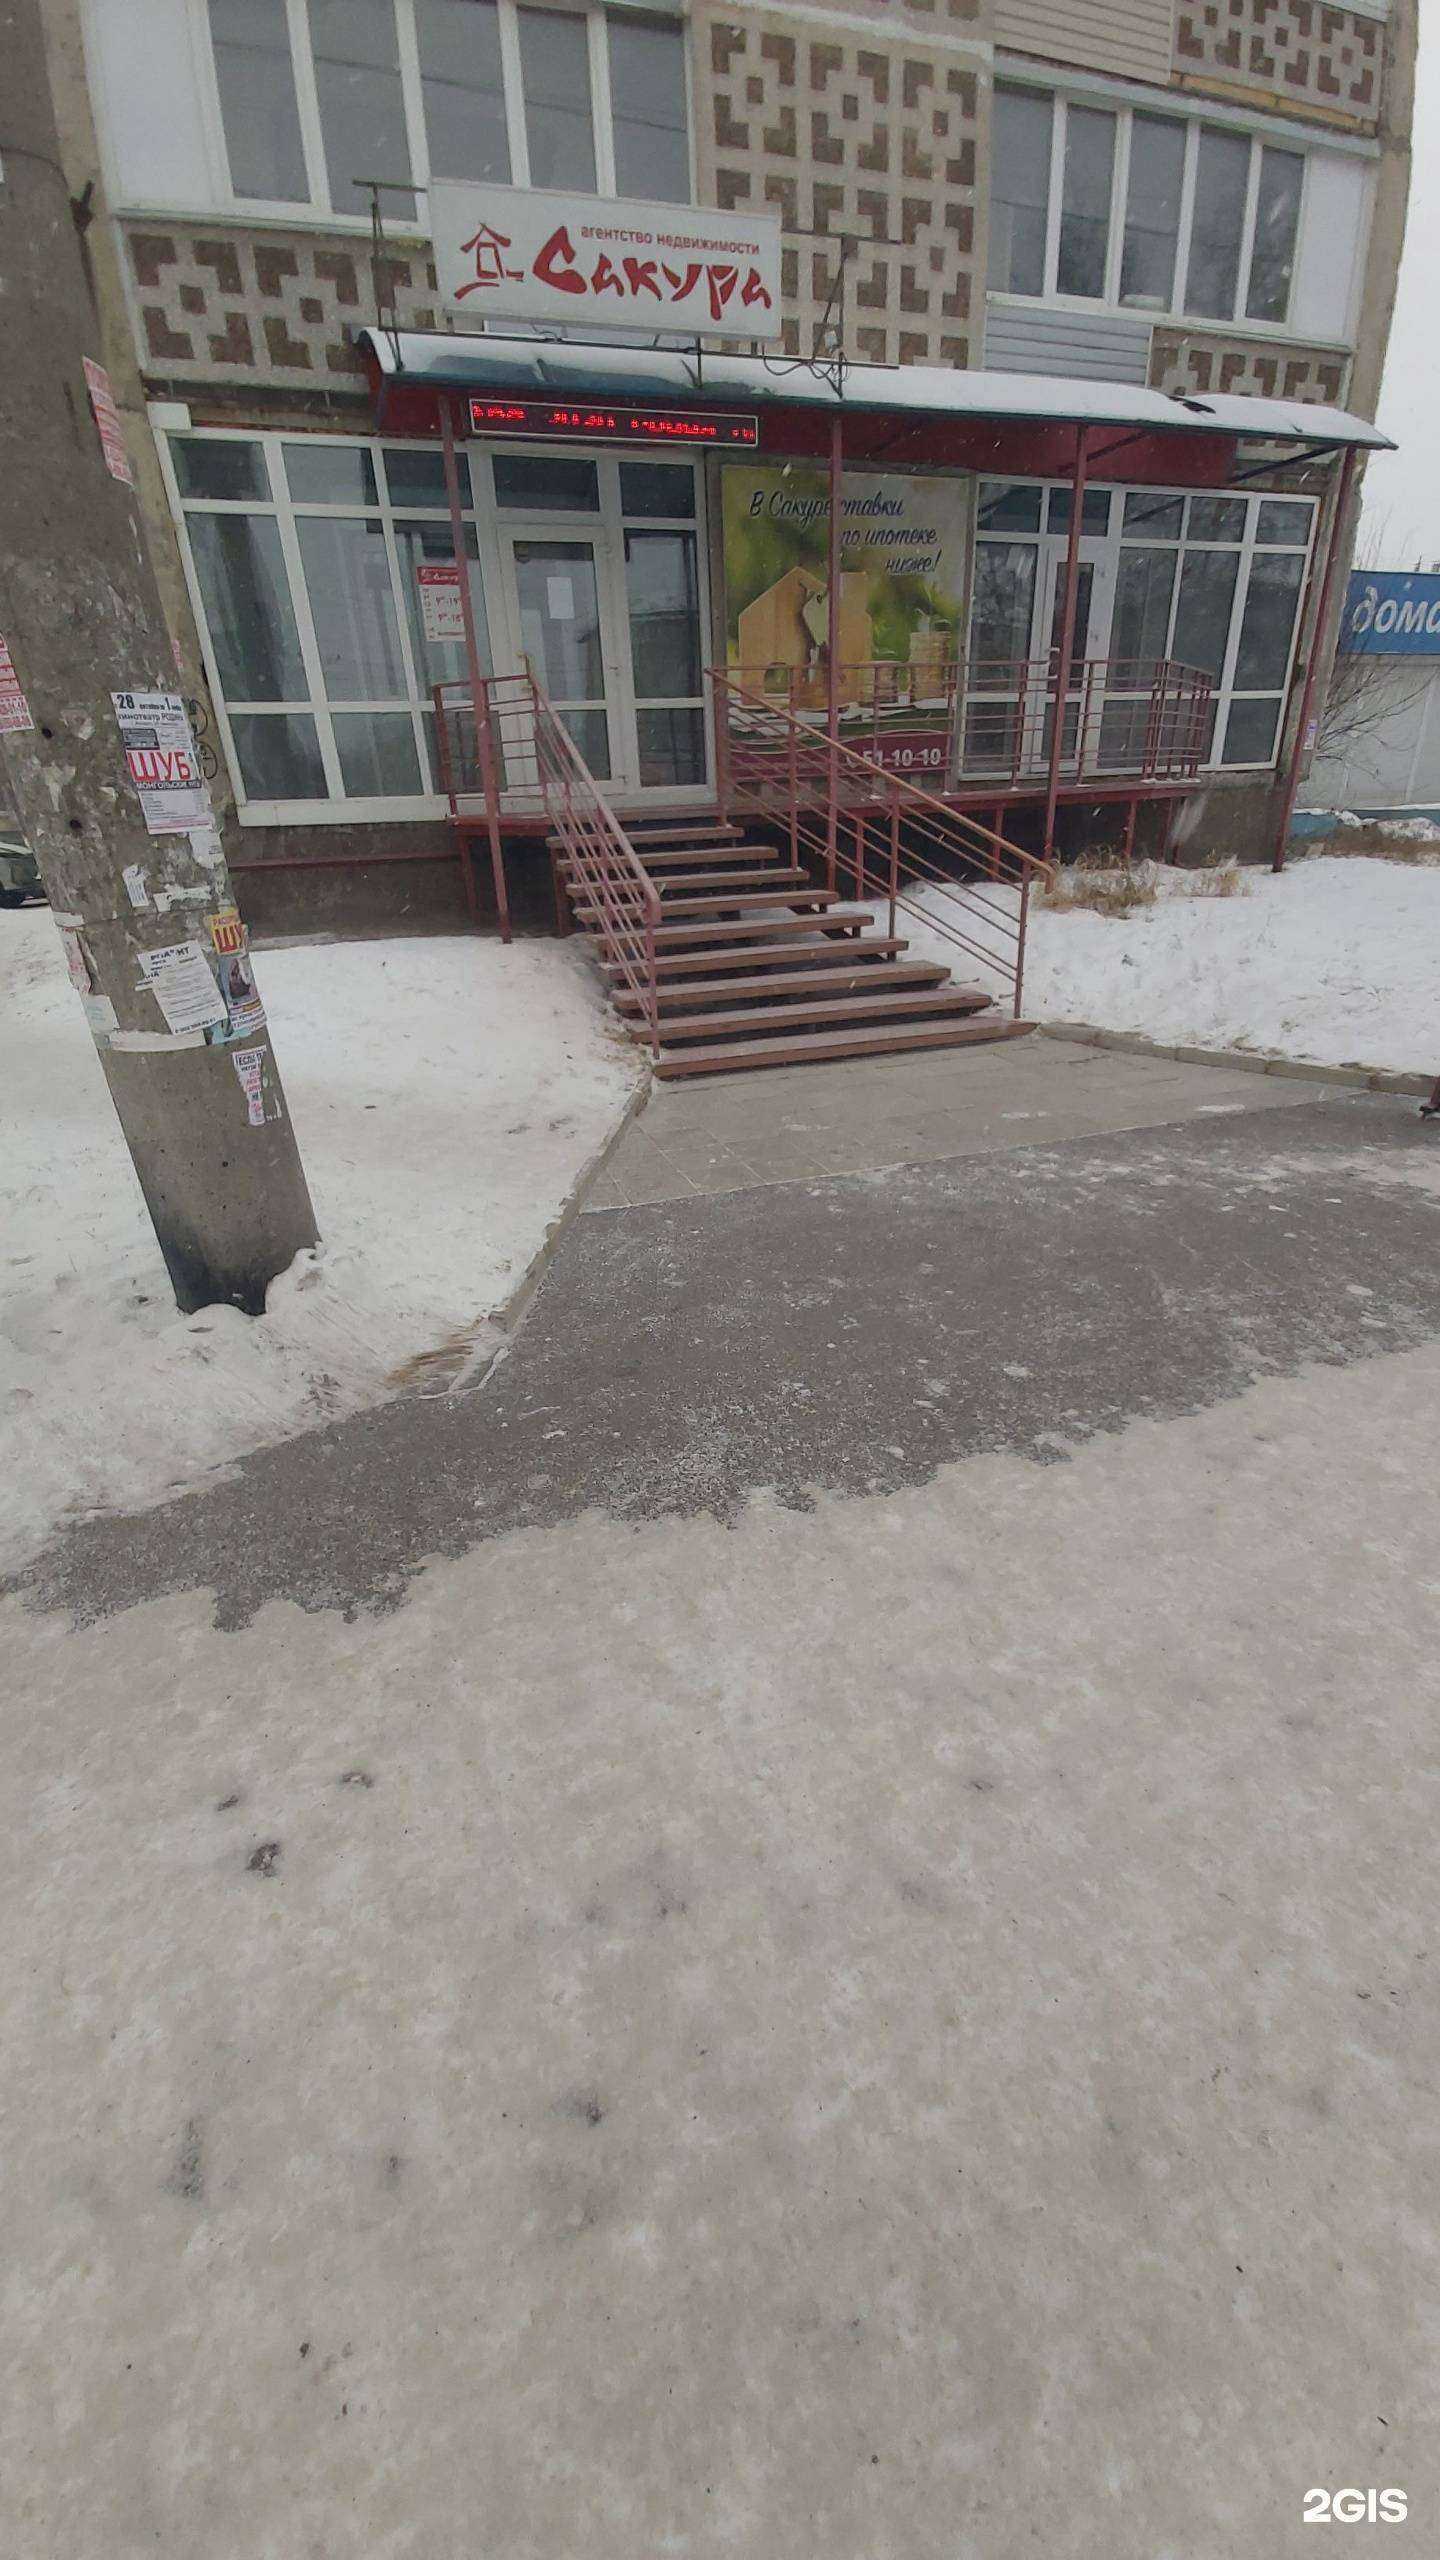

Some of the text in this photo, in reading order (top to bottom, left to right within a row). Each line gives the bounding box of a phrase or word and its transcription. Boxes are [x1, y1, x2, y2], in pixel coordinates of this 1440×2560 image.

[581, 226, 760, 255] агентство недвижимости
[532, 225, 772, 321] Сакура
[750, 490, 764, 516] В
[841, 528, 937, 546] по ипотеке
[886, 550, 942, 574] ниже!
[116, 694, 135, 709] 28
[127, 751, 191, 782] ШУБ
